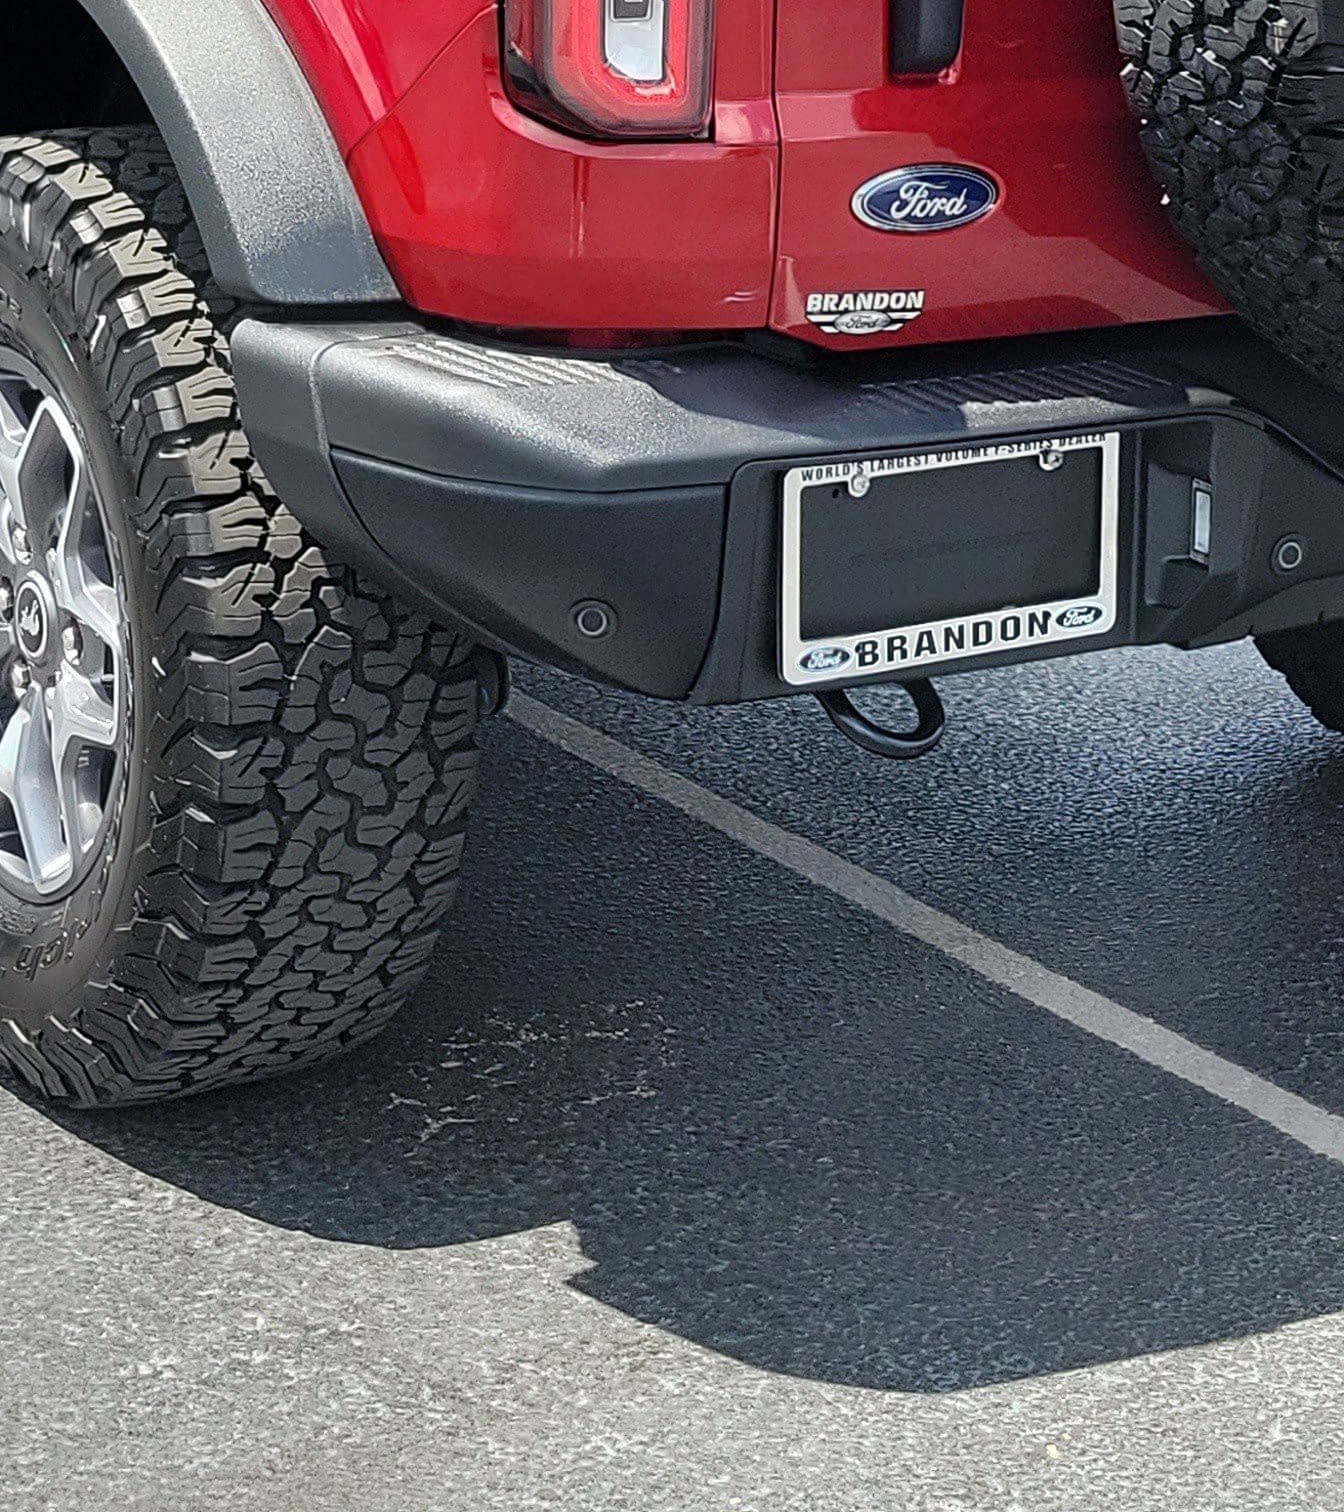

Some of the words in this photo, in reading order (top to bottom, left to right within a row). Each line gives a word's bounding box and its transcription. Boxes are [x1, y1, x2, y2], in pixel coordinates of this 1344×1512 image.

[890, 180, 968, 219] Ford
[807, 291, 925, 312] BRANDON
[844, 315, 882, 330] Ford
[871, 453, 929, 473] LARGEST
[935, 446, 988, 463] VOLUME
[805, 649, 843, 668] Ford
[857, 609, 1052, 668] BRANDON
[1062, 606, 1099, 626] Ford
